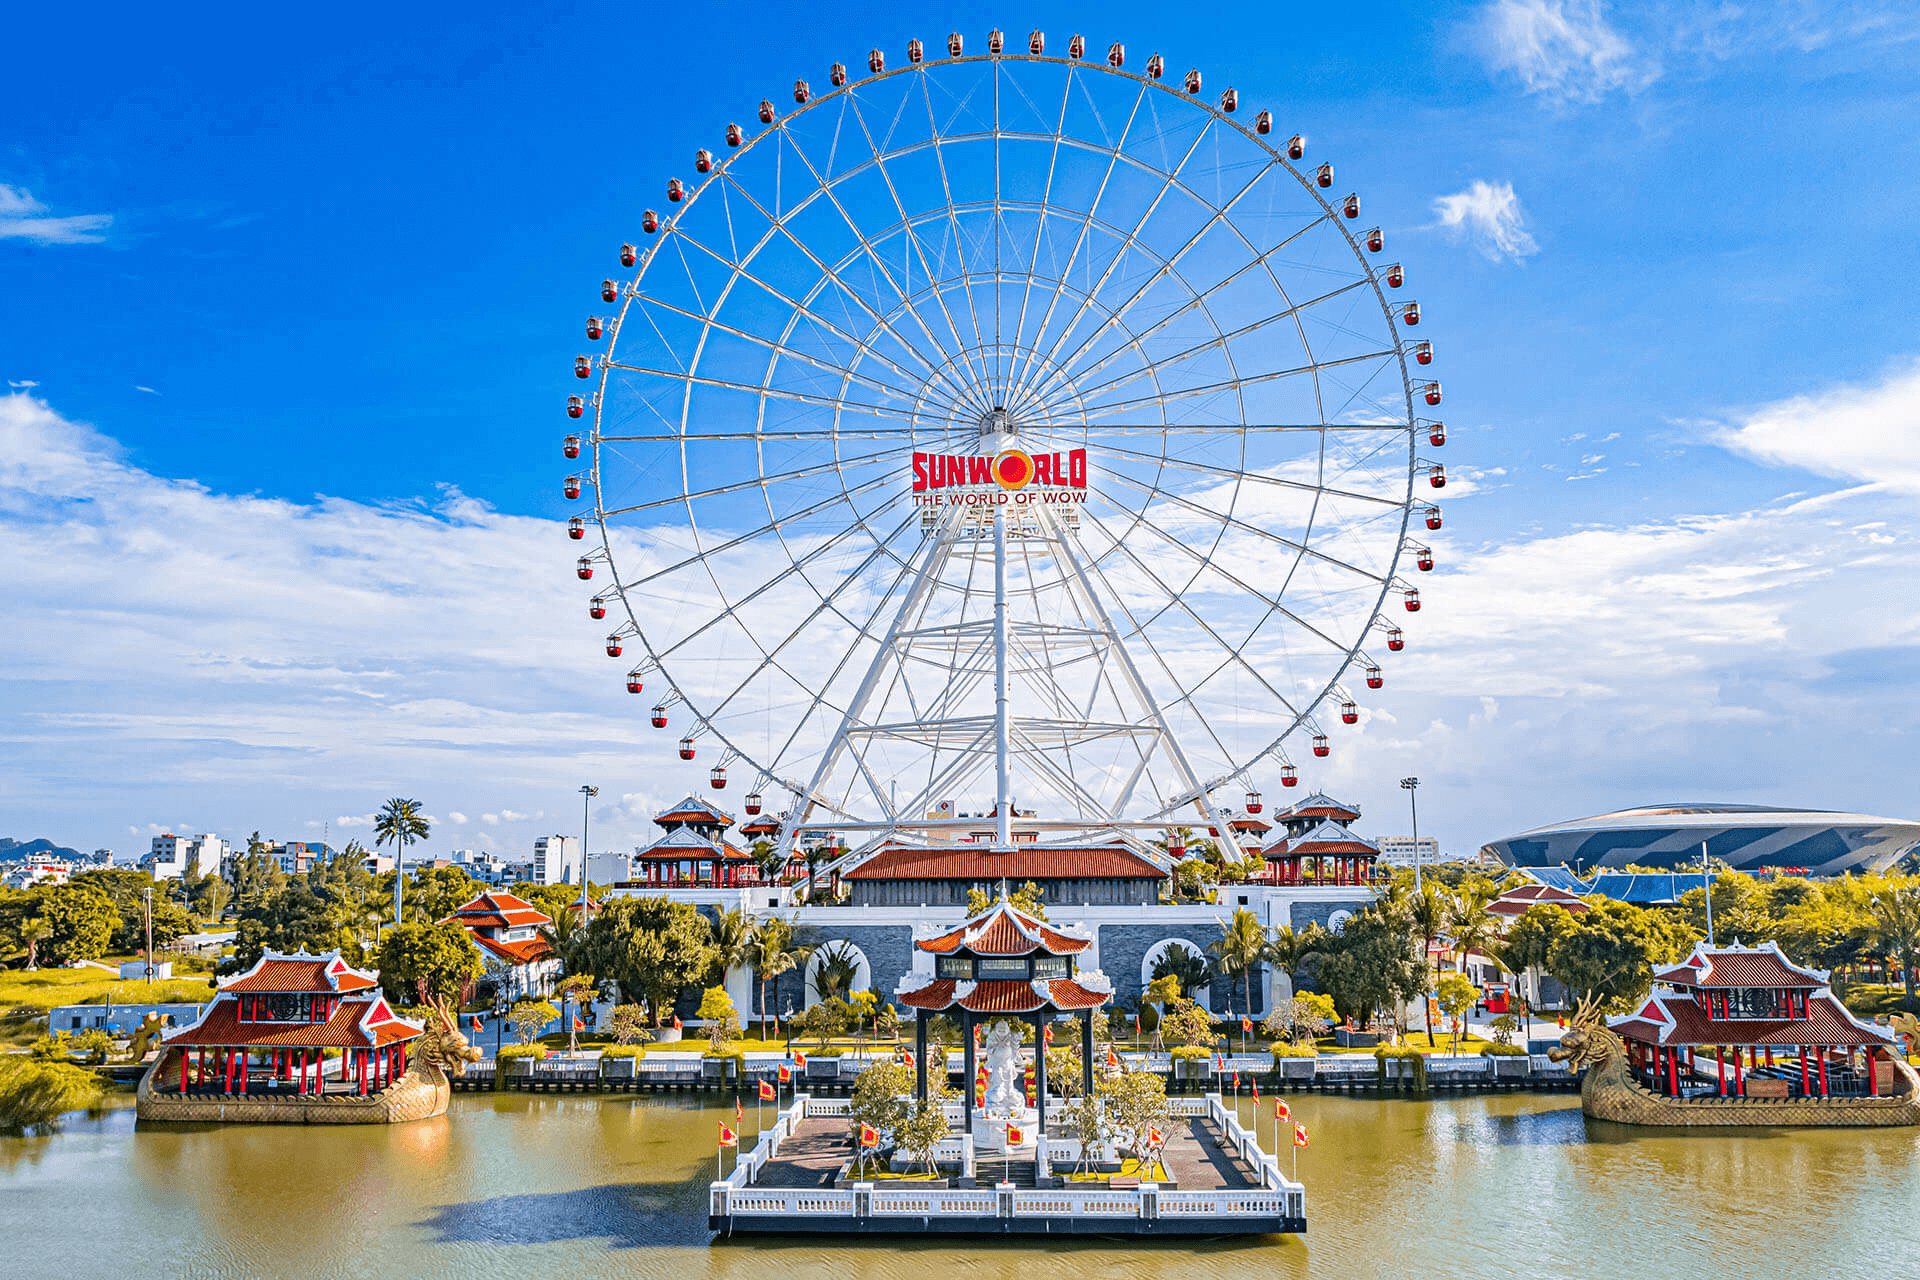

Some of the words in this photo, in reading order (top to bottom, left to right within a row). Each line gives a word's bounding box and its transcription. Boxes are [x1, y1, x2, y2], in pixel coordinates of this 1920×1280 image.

[913, 495, 942, 506] THE
[949, 493, 1009, 506] WORLD
[1015, 492, 1037, 504] OF
[1043, 491, 1088, 504] WOW
